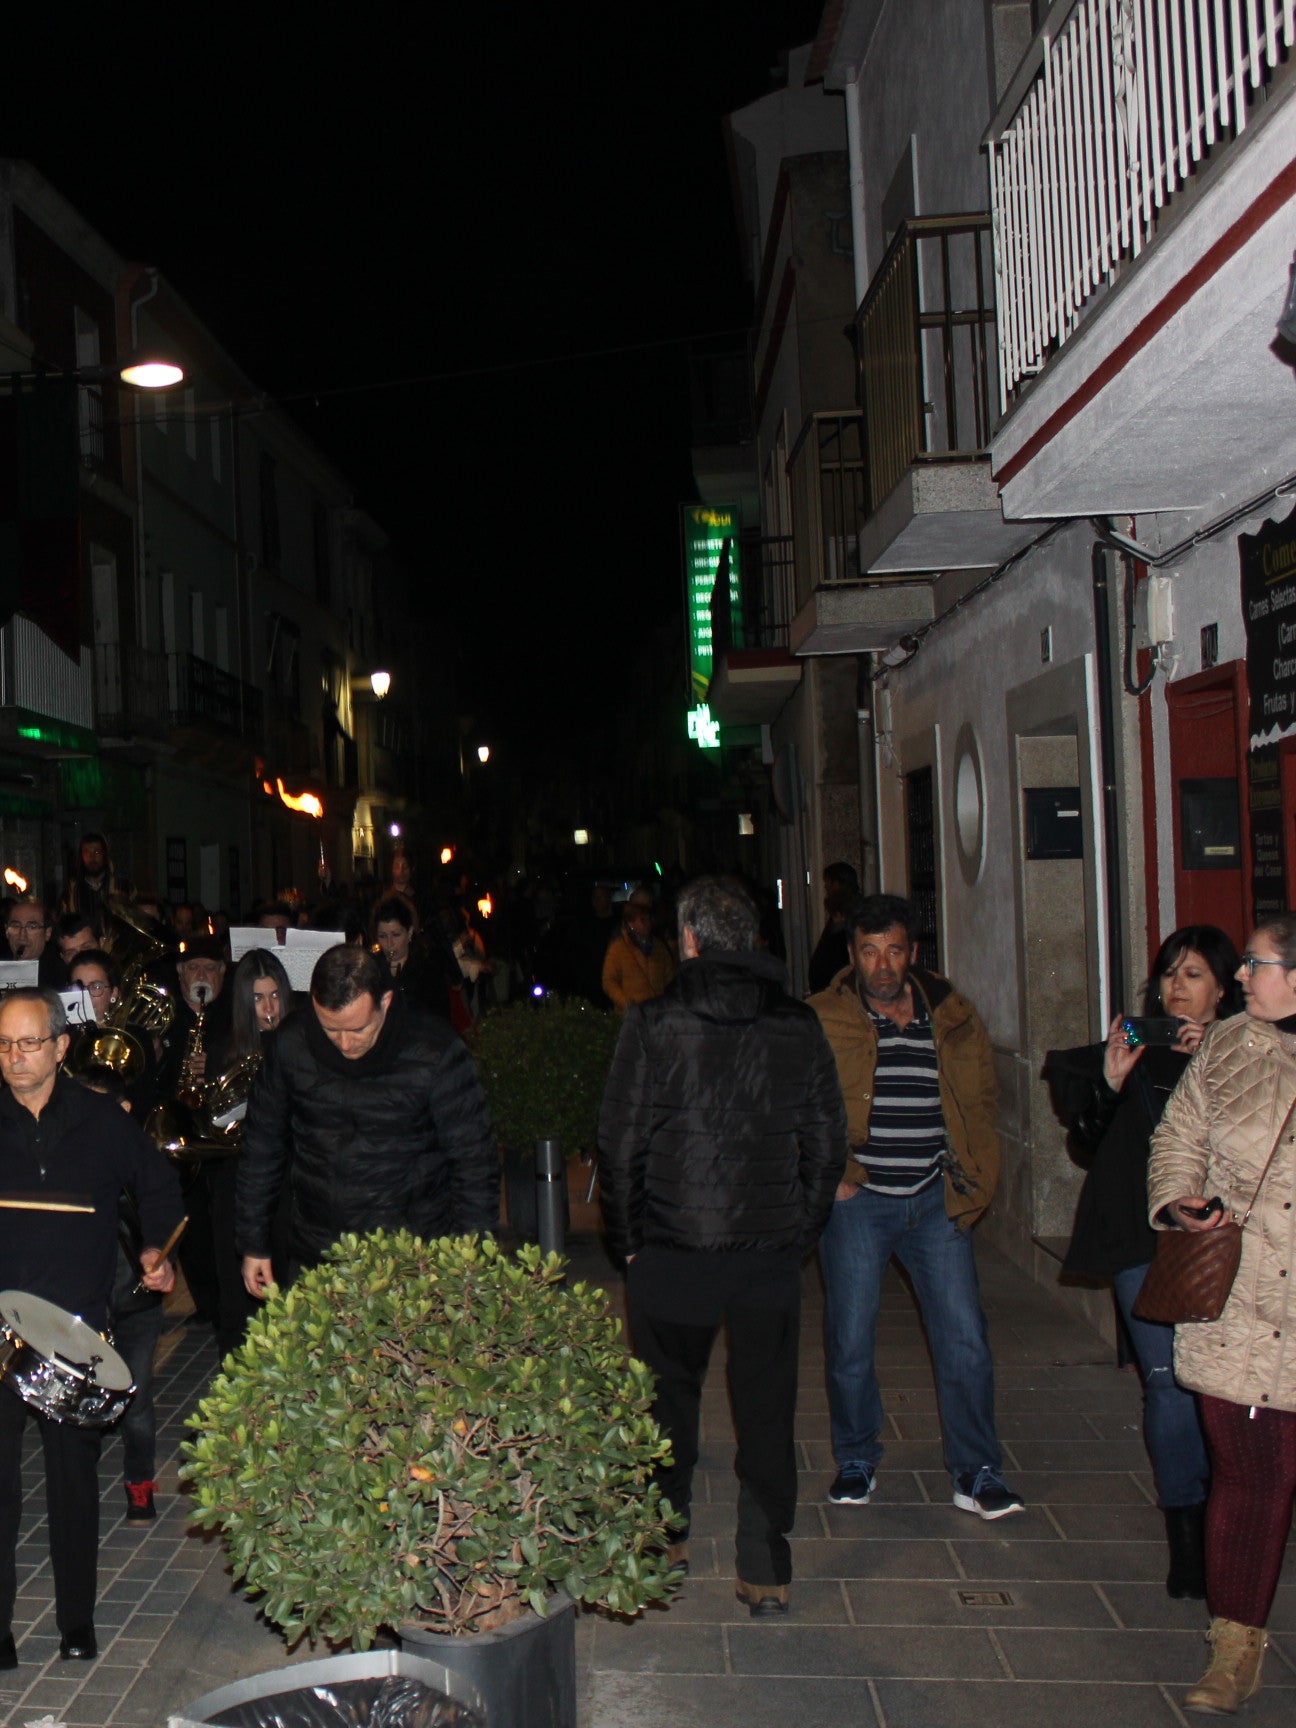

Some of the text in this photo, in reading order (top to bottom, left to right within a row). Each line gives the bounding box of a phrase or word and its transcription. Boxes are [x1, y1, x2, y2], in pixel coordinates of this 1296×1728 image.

[1249, 598, 1269, 621] Carnes
[1263, 691, 1296, 715] Frutas y
